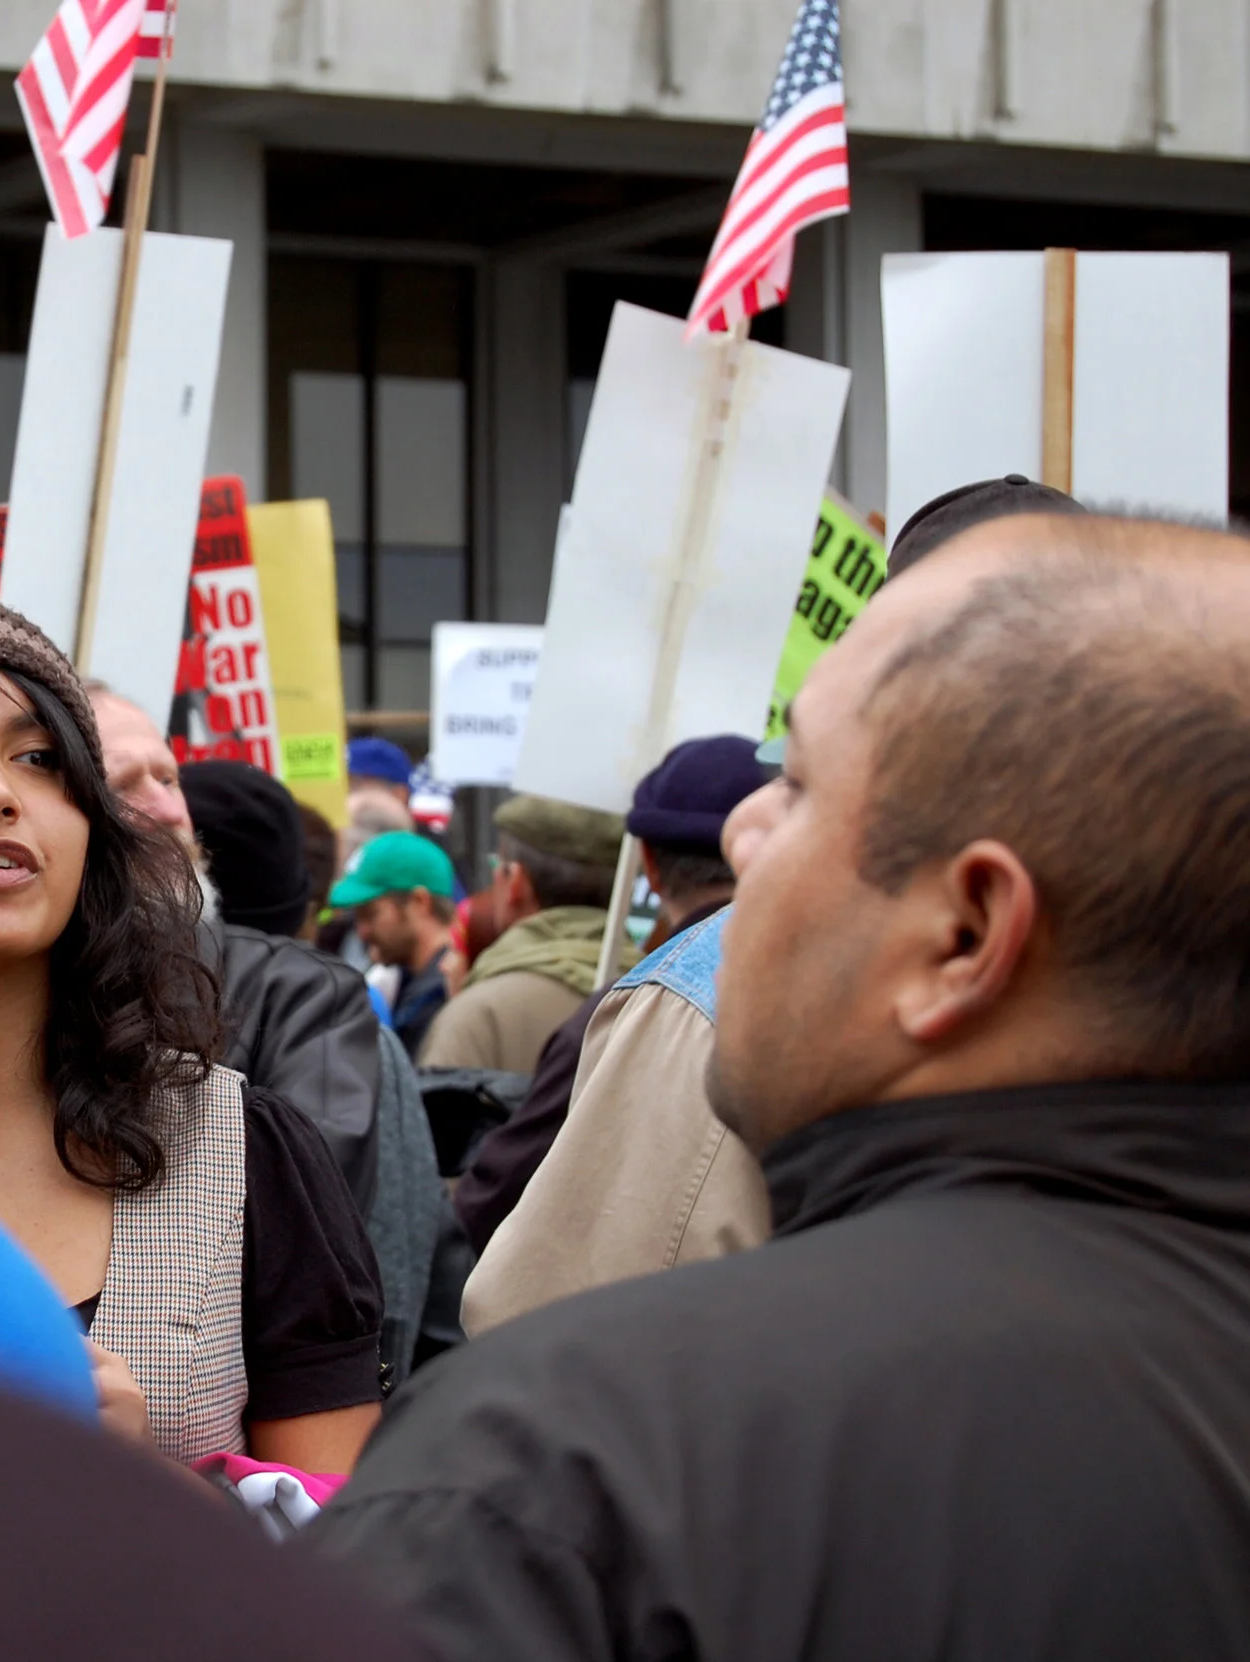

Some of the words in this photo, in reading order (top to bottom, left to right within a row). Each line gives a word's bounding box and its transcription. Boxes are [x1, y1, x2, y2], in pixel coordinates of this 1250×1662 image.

[190, 581, 253, 635] No
[206, 687, 266, 733] on
[445, 713, 518, 737] BRING
